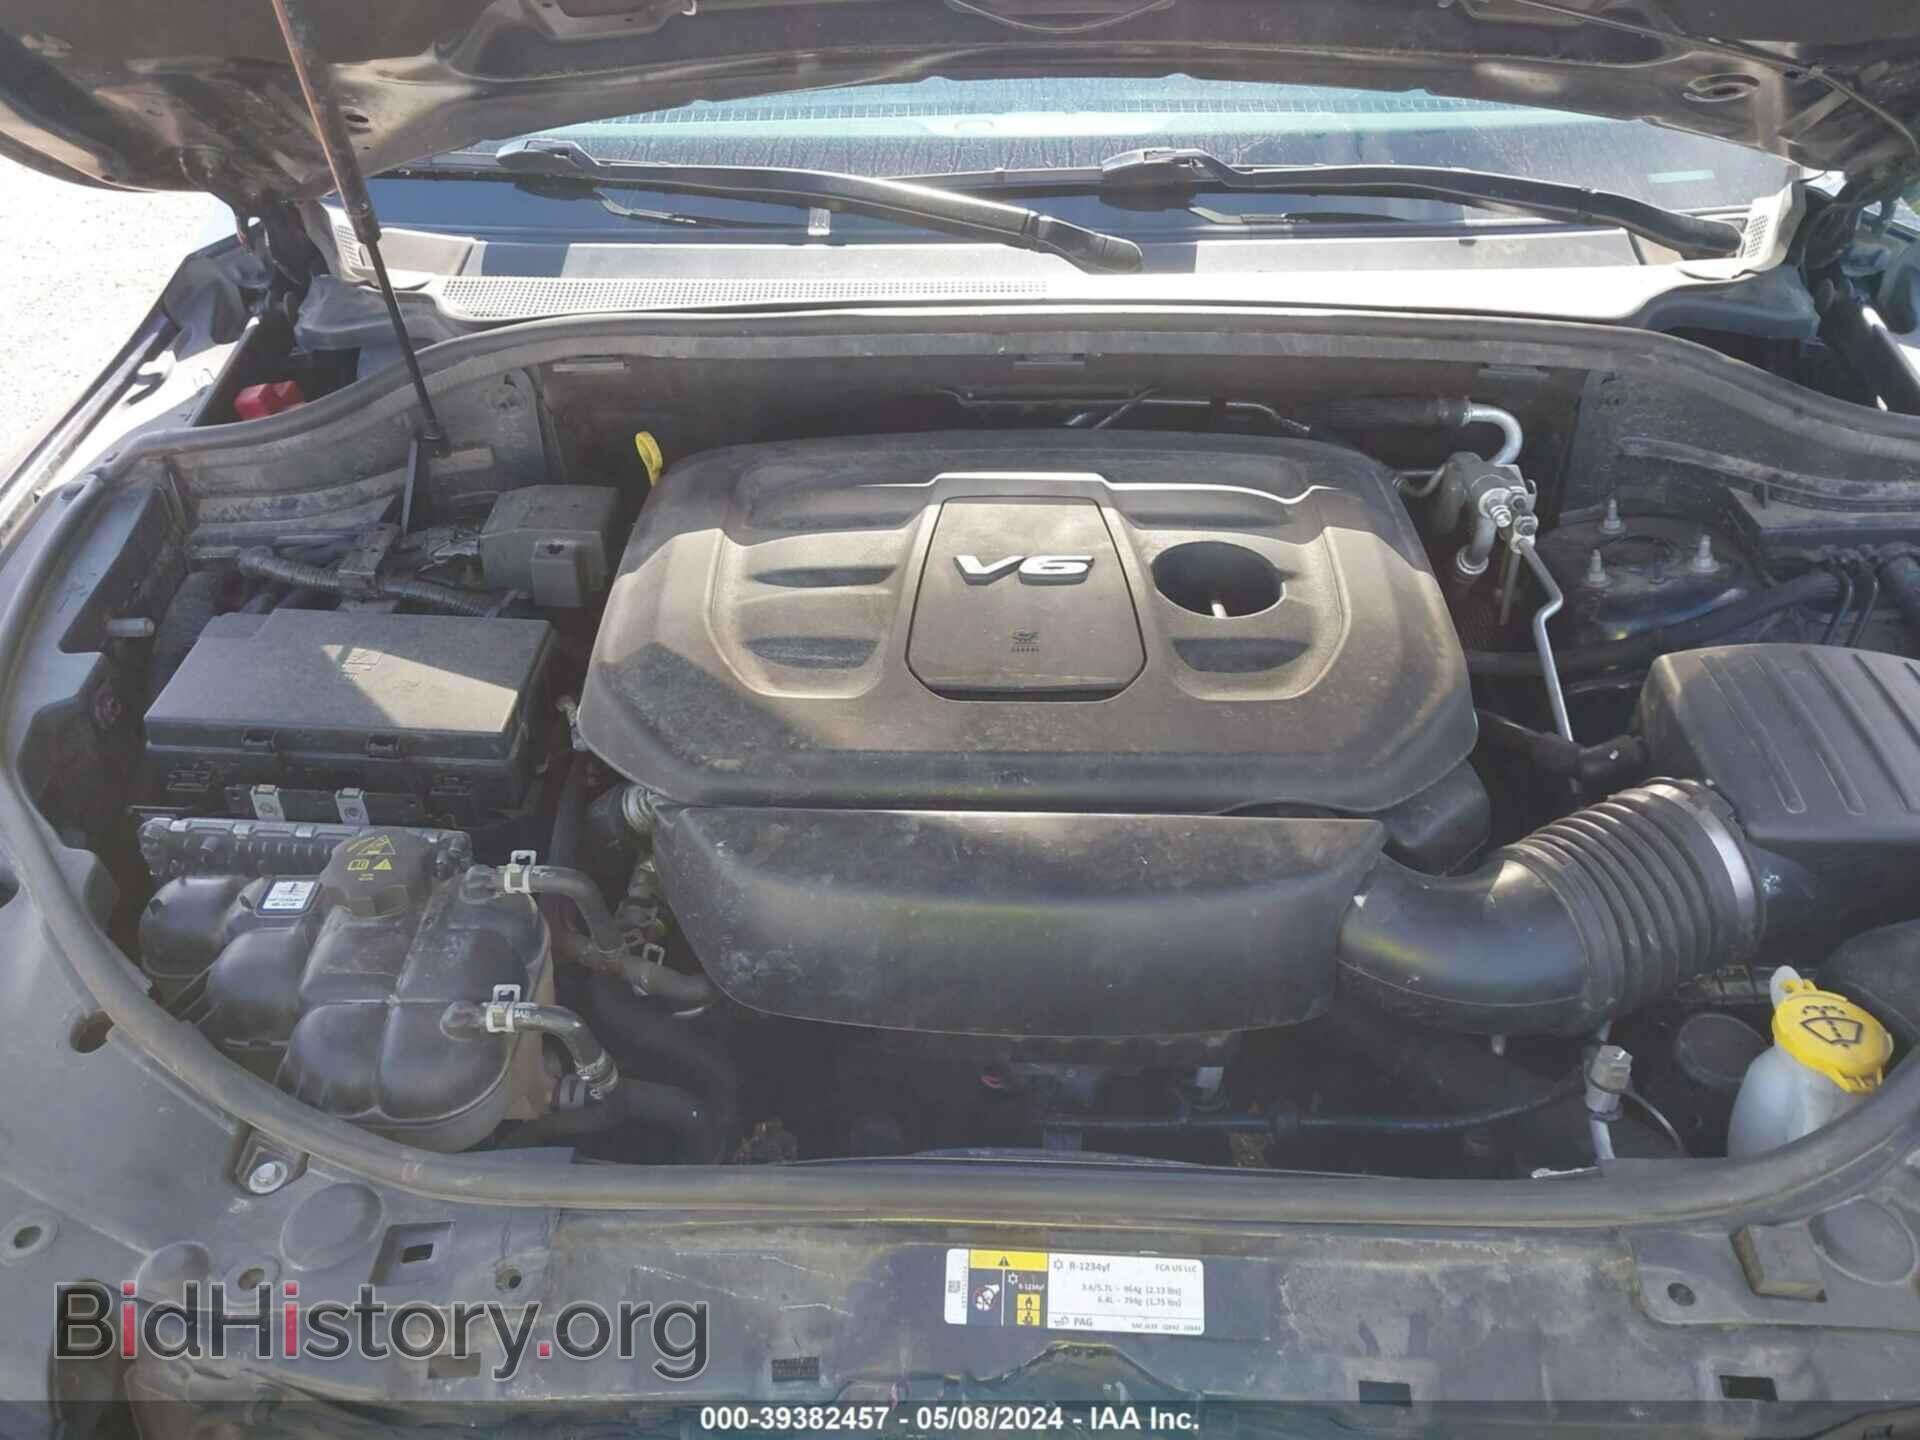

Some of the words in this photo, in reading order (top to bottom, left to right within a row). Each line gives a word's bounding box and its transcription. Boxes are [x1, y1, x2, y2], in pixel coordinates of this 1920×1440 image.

[953, 554, 1095, 586] V6
[1069, 1261, 1111, 1273] R-1234yf
[1155, 1263, 1170, 1272] FCA
[1171, 1264, 1183, 1272] US
[1184, 1264, 1198, 1273] LLC
[1073, 1317, 1094, 1327] PAG
